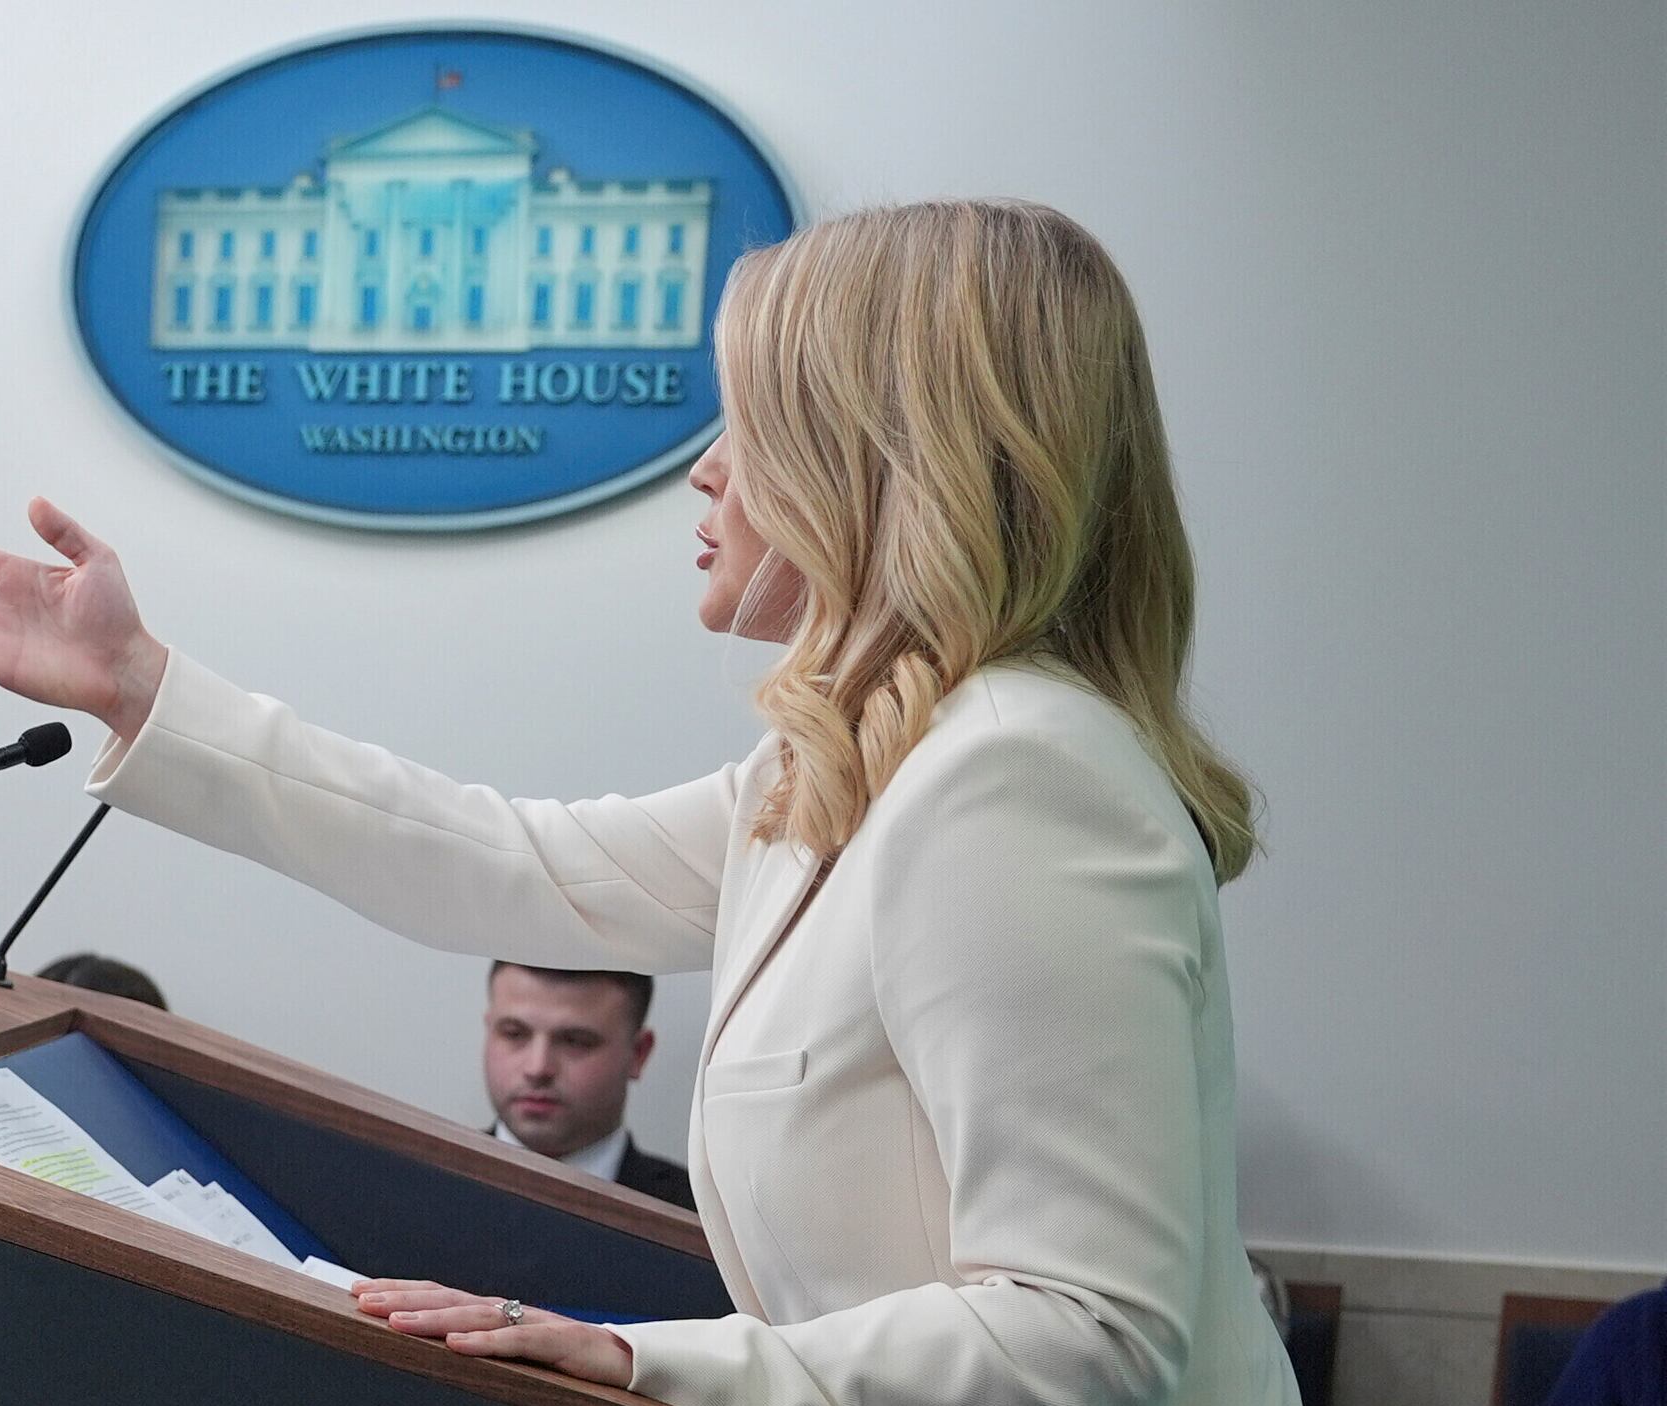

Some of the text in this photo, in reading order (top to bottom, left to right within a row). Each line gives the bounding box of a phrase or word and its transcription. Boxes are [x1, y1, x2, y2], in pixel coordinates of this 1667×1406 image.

[164, 361, 684, 404] THE WHITE HOUSE
[300, 424, 543, 453] WASHINGTON
